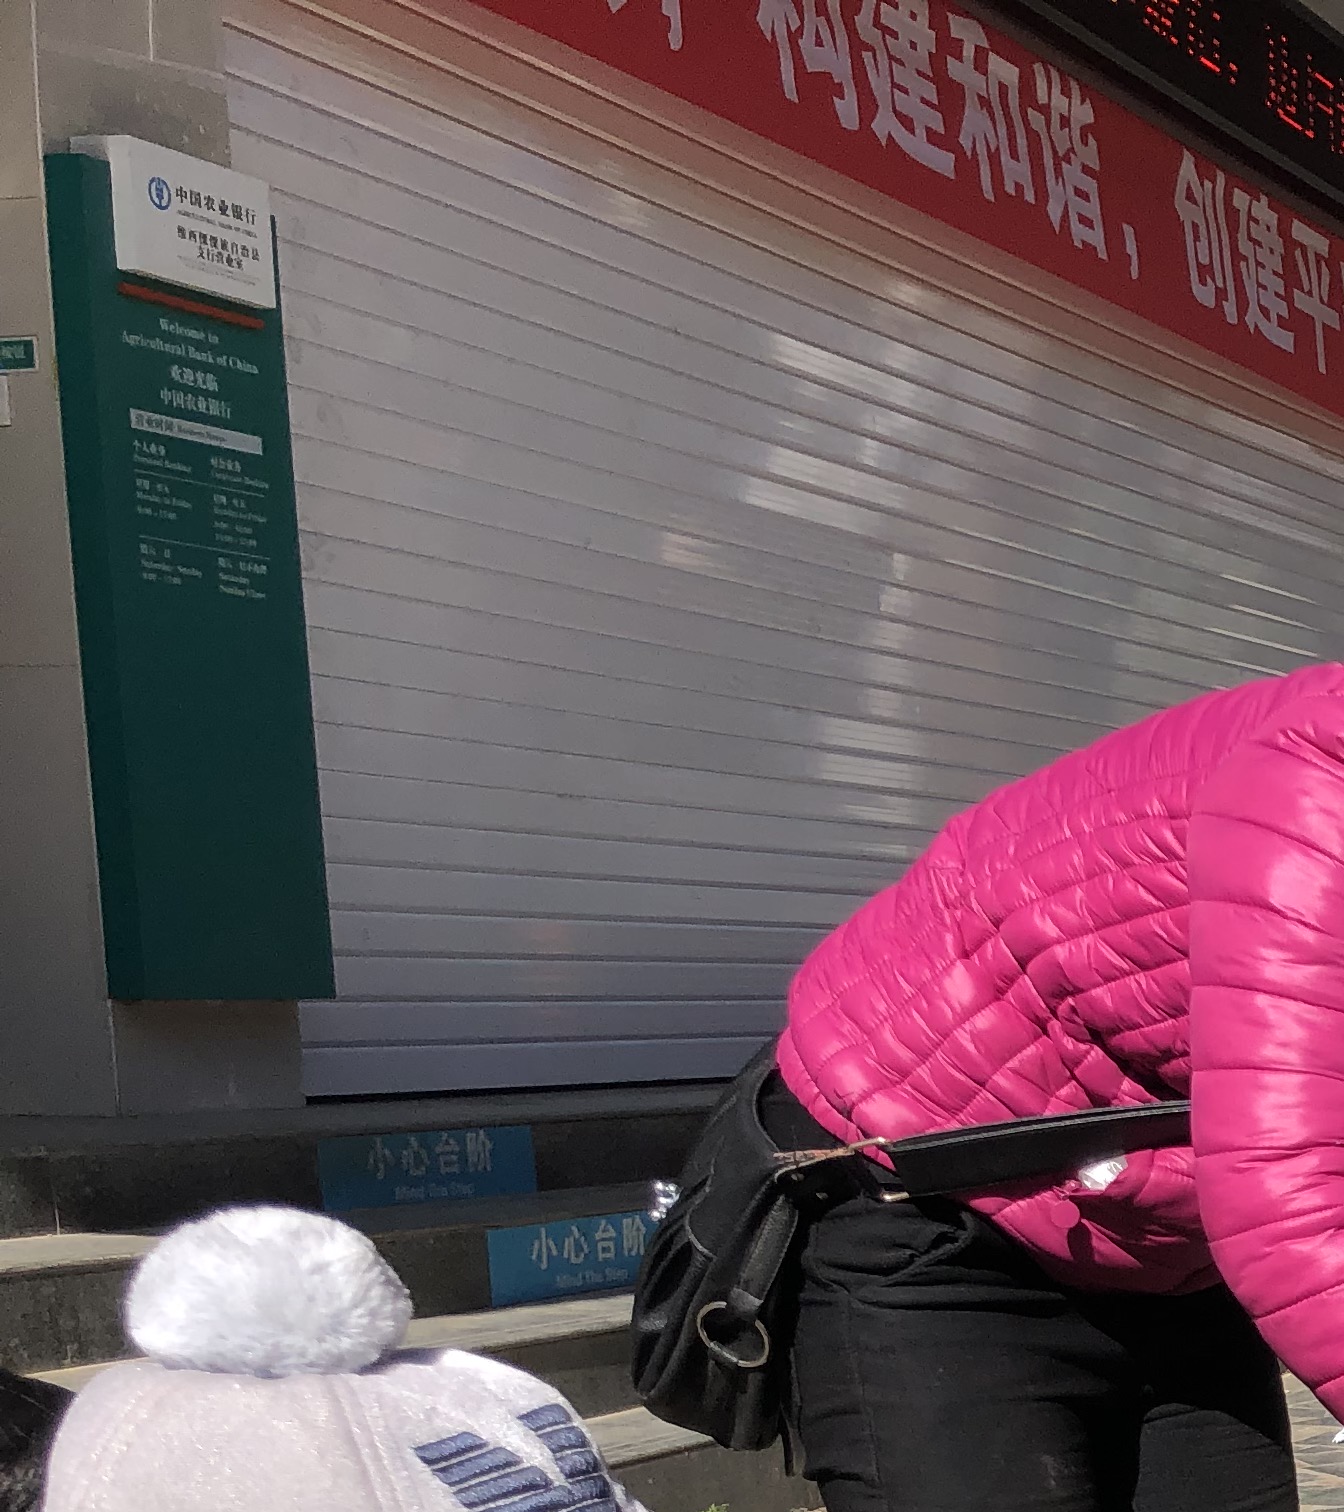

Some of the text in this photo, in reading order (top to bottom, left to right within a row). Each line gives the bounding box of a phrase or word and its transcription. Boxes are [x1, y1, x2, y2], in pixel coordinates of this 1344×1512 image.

[175, 185, 257, 226] 中国农业银行
[122, 330, 260, 374] Agricultural Bank of China
[159, 318, 219, 344] Welcome to
[368, 1129, 493, 1179] 小心台阶
[531, 1215, 647, 1270] 小心台阶
